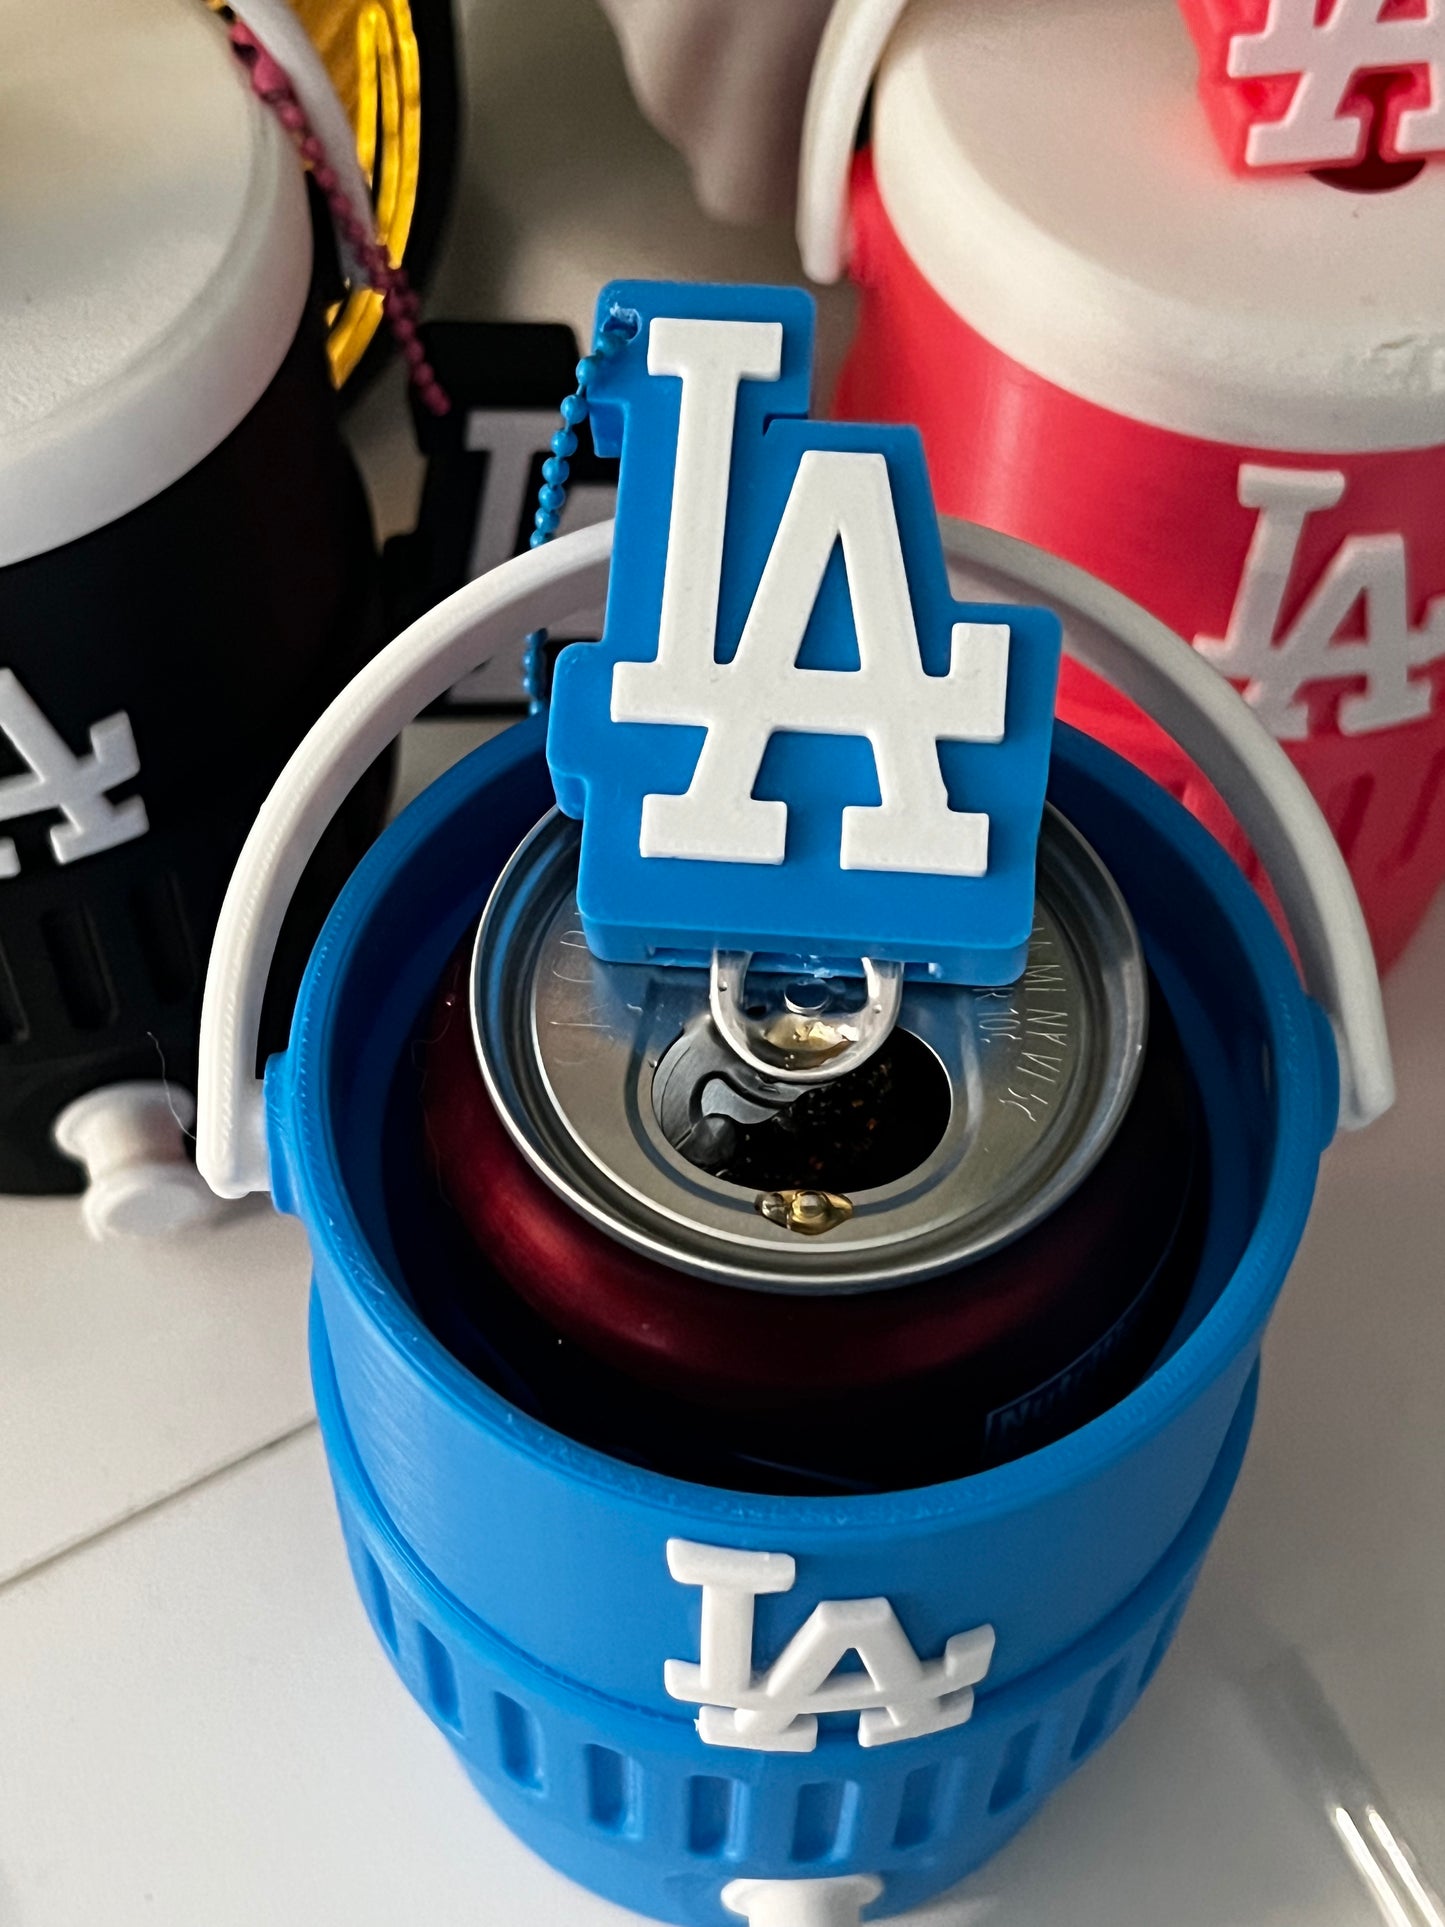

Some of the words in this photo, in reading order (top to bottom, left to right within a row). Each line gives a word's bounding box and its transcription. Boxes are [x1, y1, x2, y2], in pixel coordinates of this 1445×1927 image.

[610, 317, 1010, 877] LA
[1193, 462, 1445, 741] LA
[664, 1537, 997, 1753] LA
